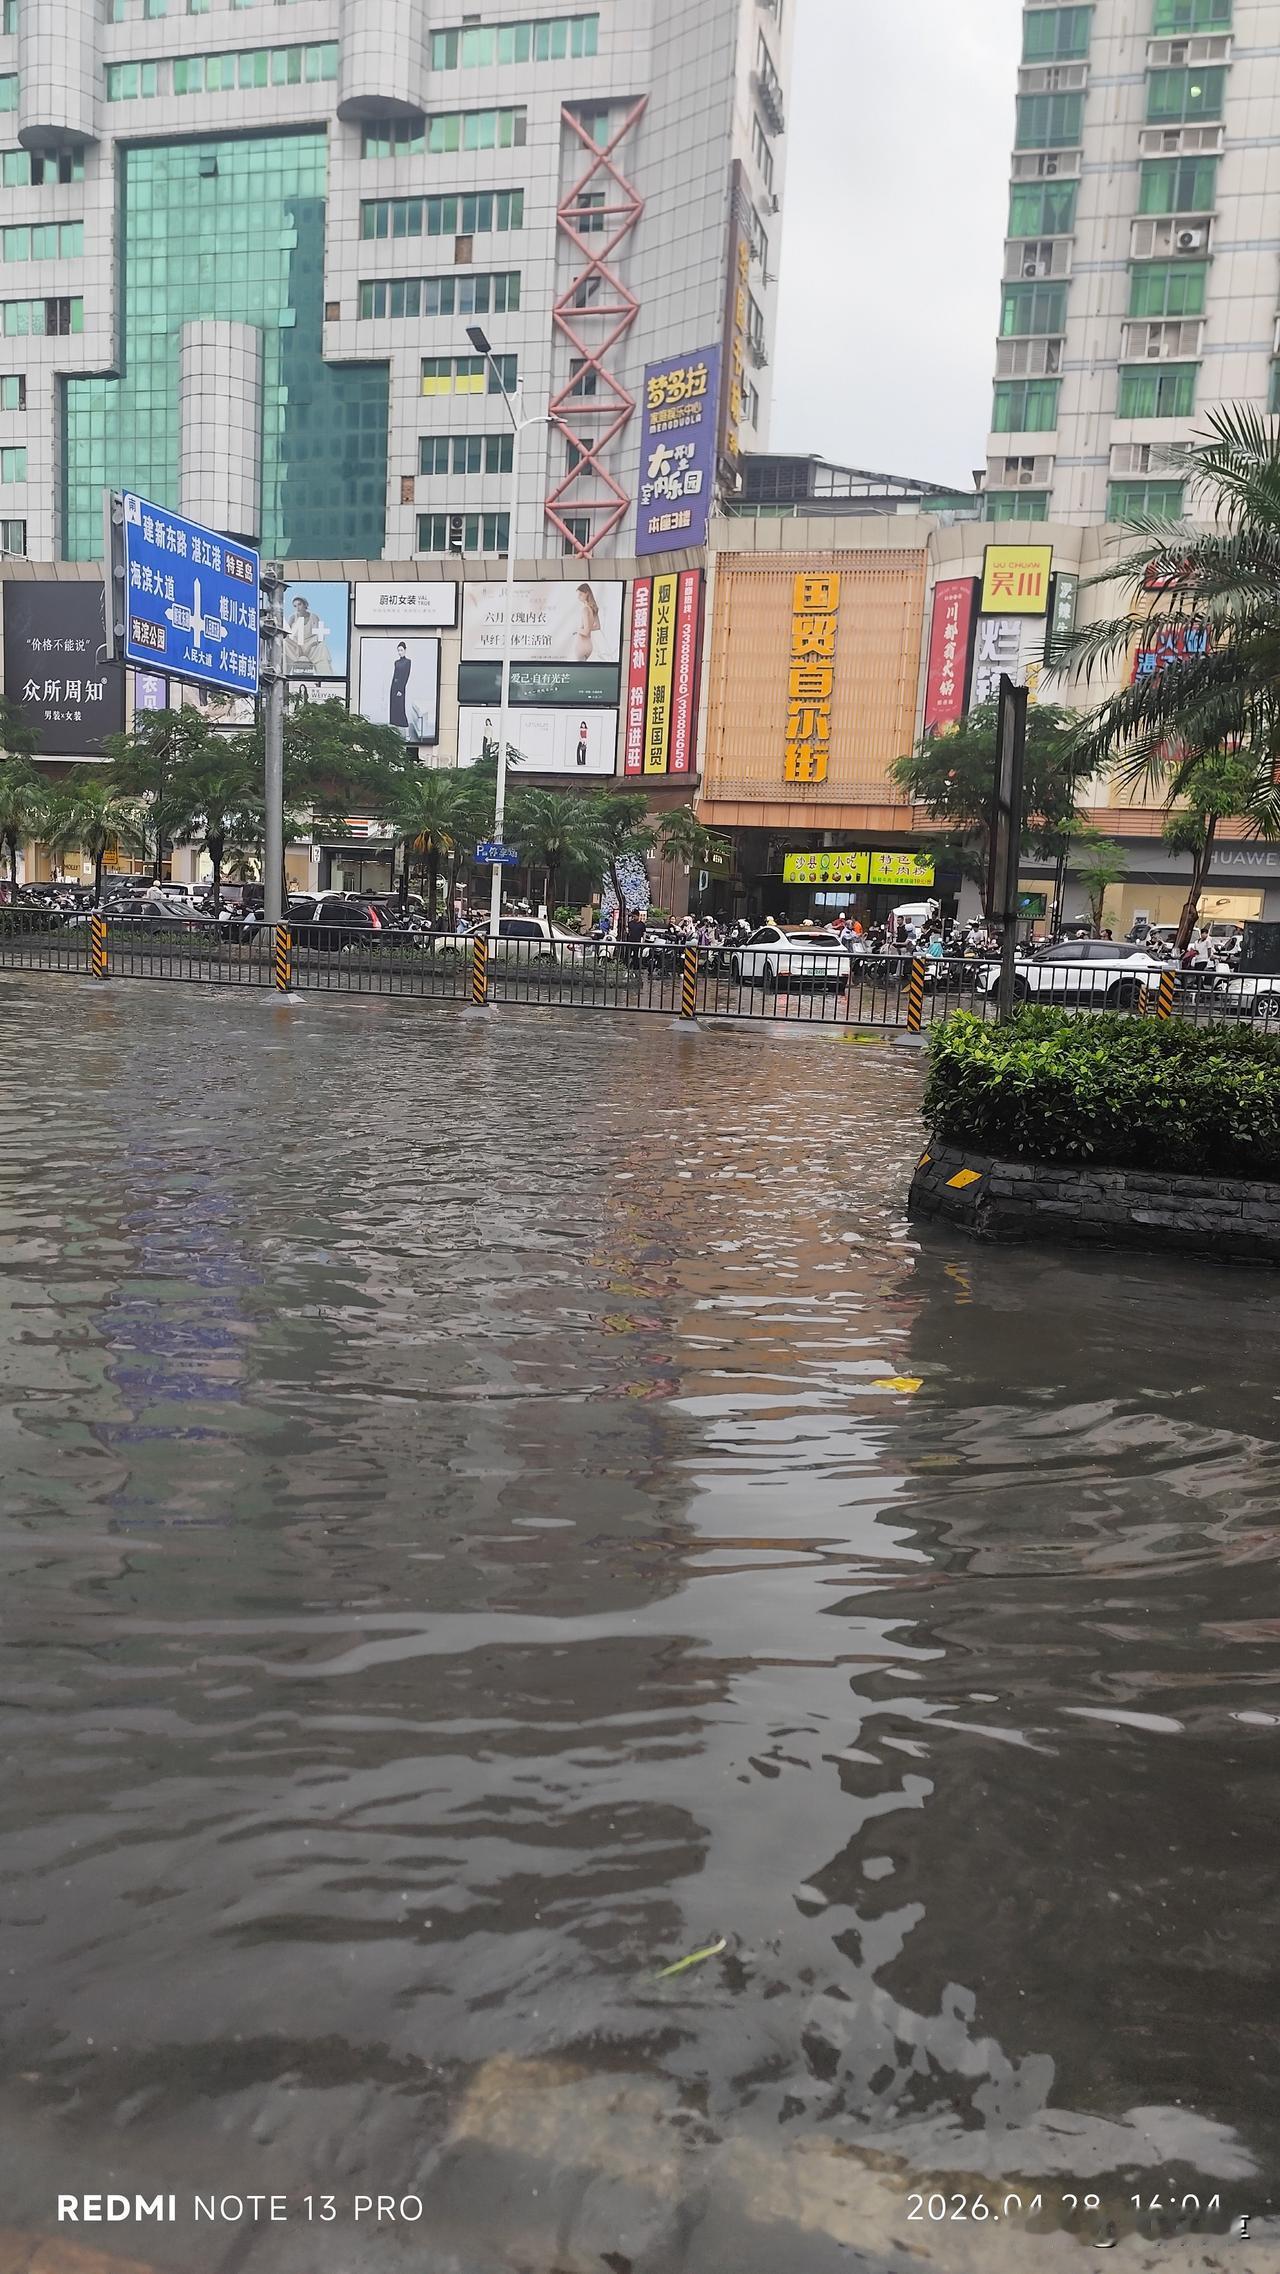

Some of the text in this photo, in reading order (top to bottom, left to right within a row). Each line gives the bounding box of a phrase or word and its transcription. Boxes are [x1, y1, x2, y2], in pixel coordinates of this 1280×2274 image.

[647, 363, 707, 409] 梦多拉
[649, 413, 701, 434] MENGDUOLA
[647, 443, 695, 478] 大型
[648, 509, 691, 534] 本座3楼
[143, 515, 253, 582] 建新东路 湛江港 特呈岛
[130, 561, 175, 601] 海滨大道
[991, 572, 1042, 597] 吴川
[132, 619, 165, 650] 海滨公园
[183, 646, 213, 667] 人民大道
[220, 646, 257, 680] 火车南站
[628, 587, 649, 767] 全额装补 拎包进驻
[650, 584, 671, 765] 烟火湛江 潮起国贸
